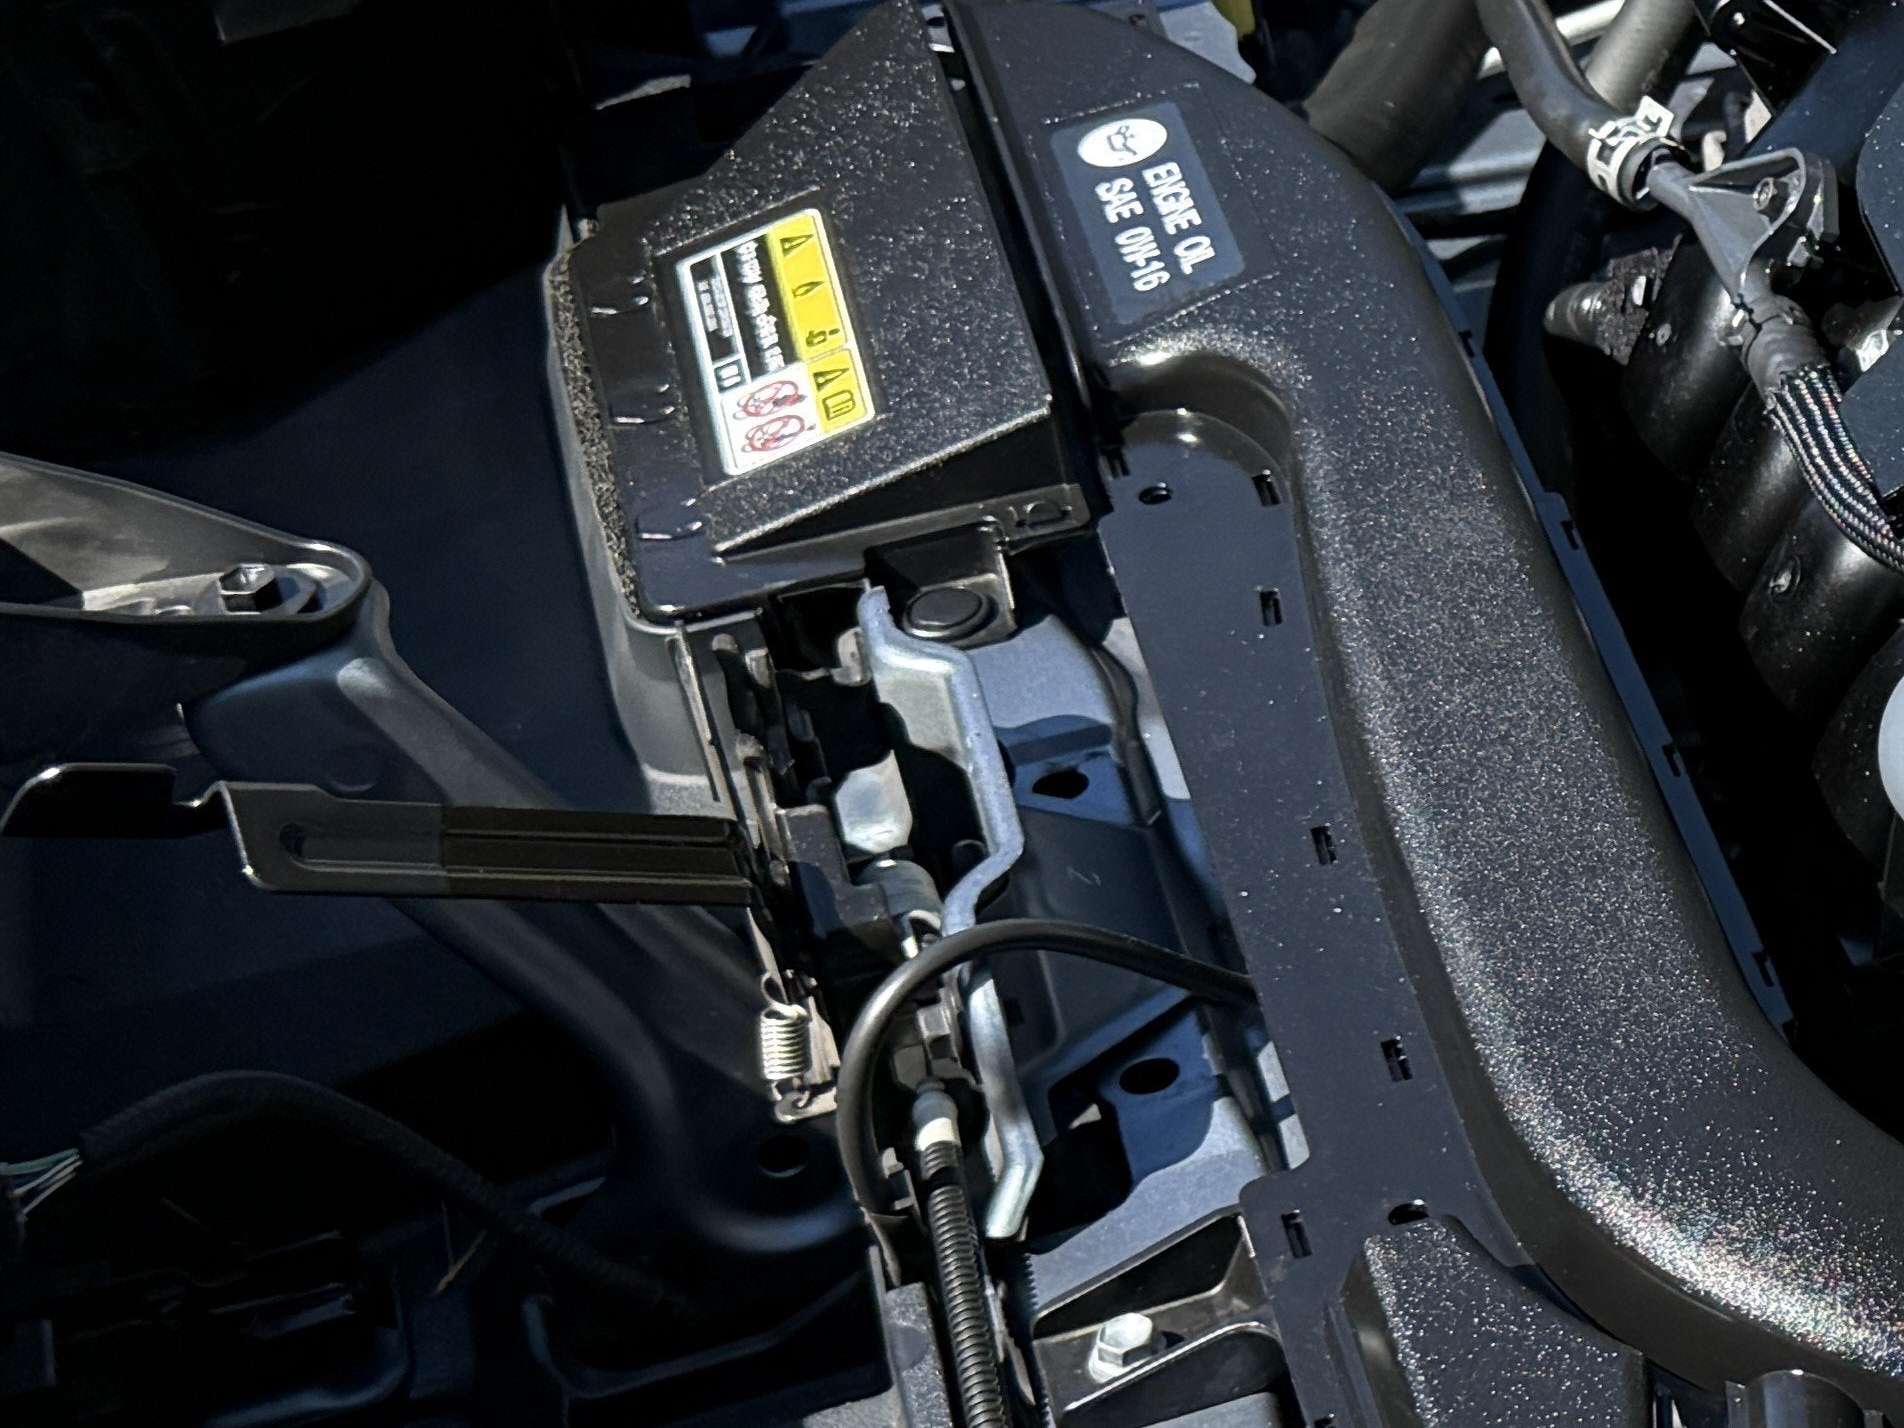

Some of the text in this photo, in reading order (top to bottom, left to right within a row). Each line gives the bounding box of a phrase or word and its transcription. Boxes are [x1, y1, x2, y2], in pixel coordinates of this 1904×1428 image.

[1093, 174, 1172, 296] SAE 0W-16
[1140, 159, 1219, 276] ENGINE OIL
